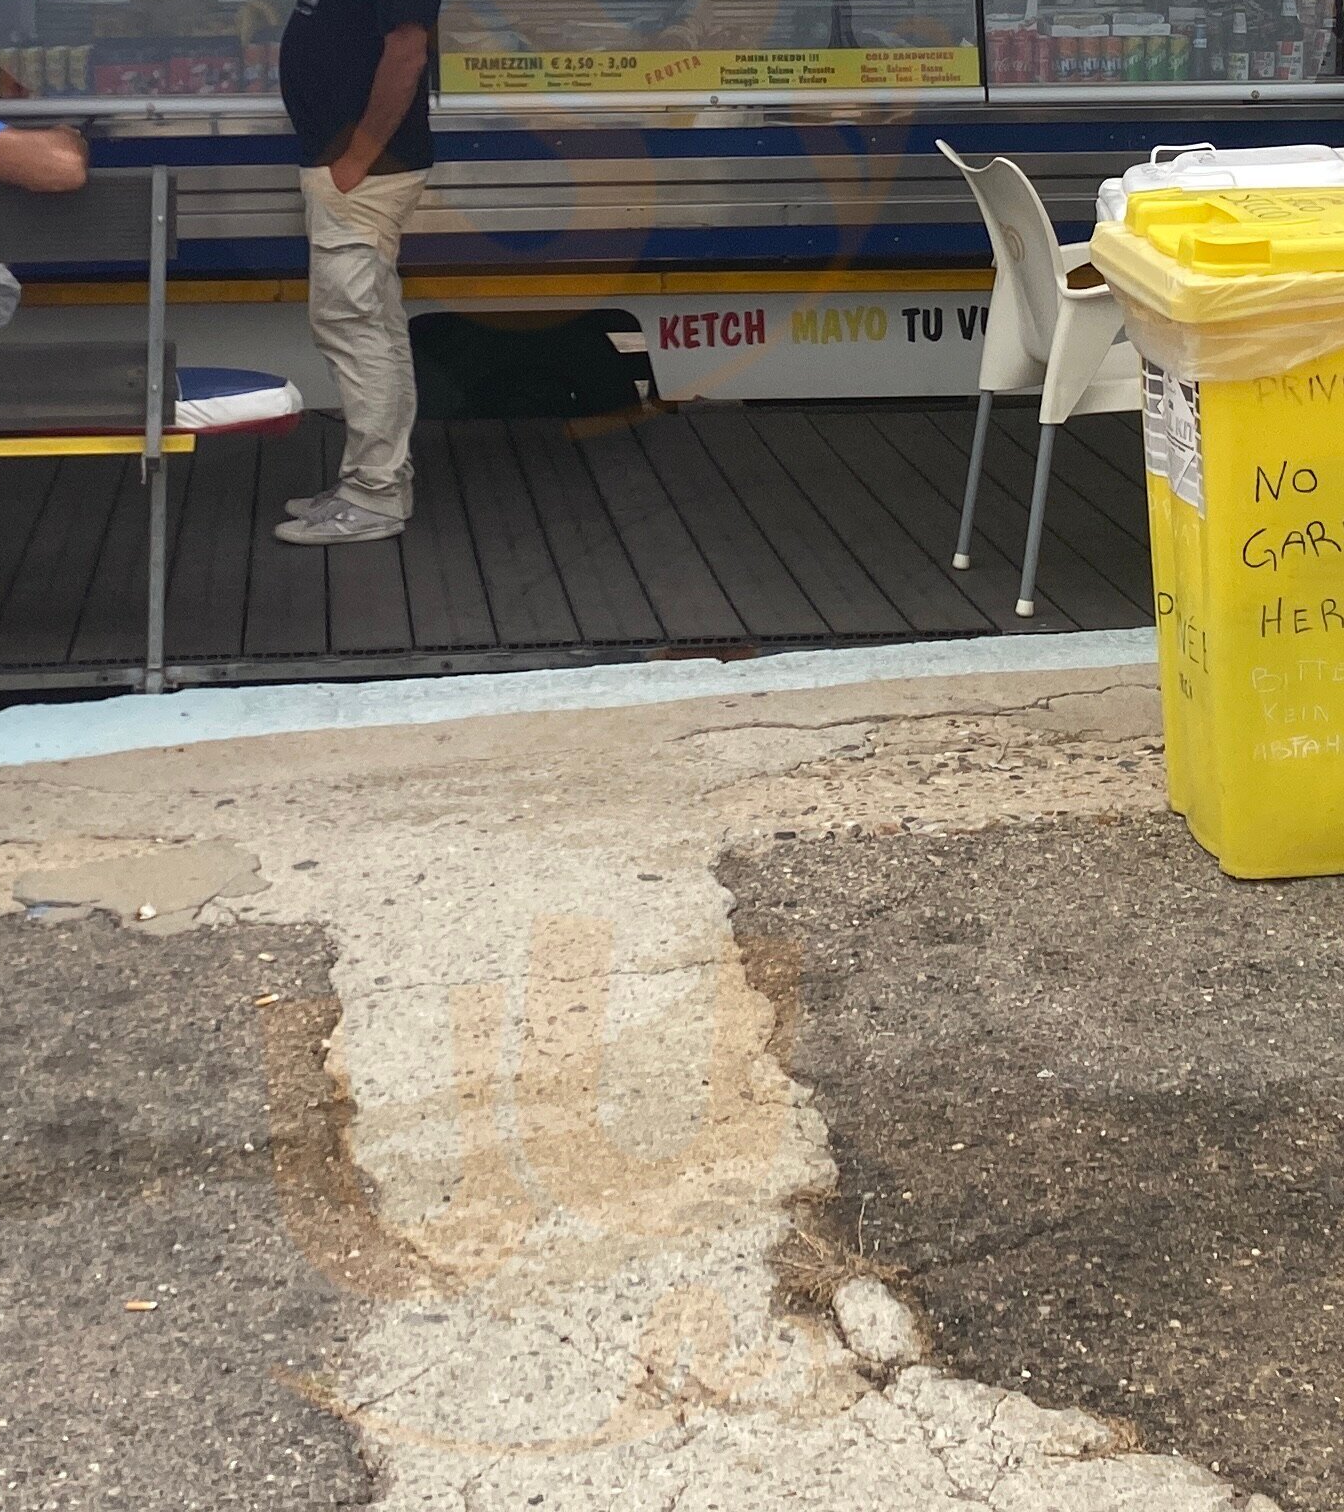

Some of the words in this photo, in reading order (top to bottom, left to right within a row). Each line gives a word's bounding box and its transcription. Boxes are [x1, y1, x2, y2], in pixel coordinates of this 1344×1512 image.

[463, 57, 542, 70] TRAMEZZINI
[644, 55, 702, 85] FRUTTA
[659, 309, 766, 350] KETCH
[791, 305, 888, 345] MAYO
[902, 307, 944, 343] TU
[1255, 459, 1319, 504] NO
